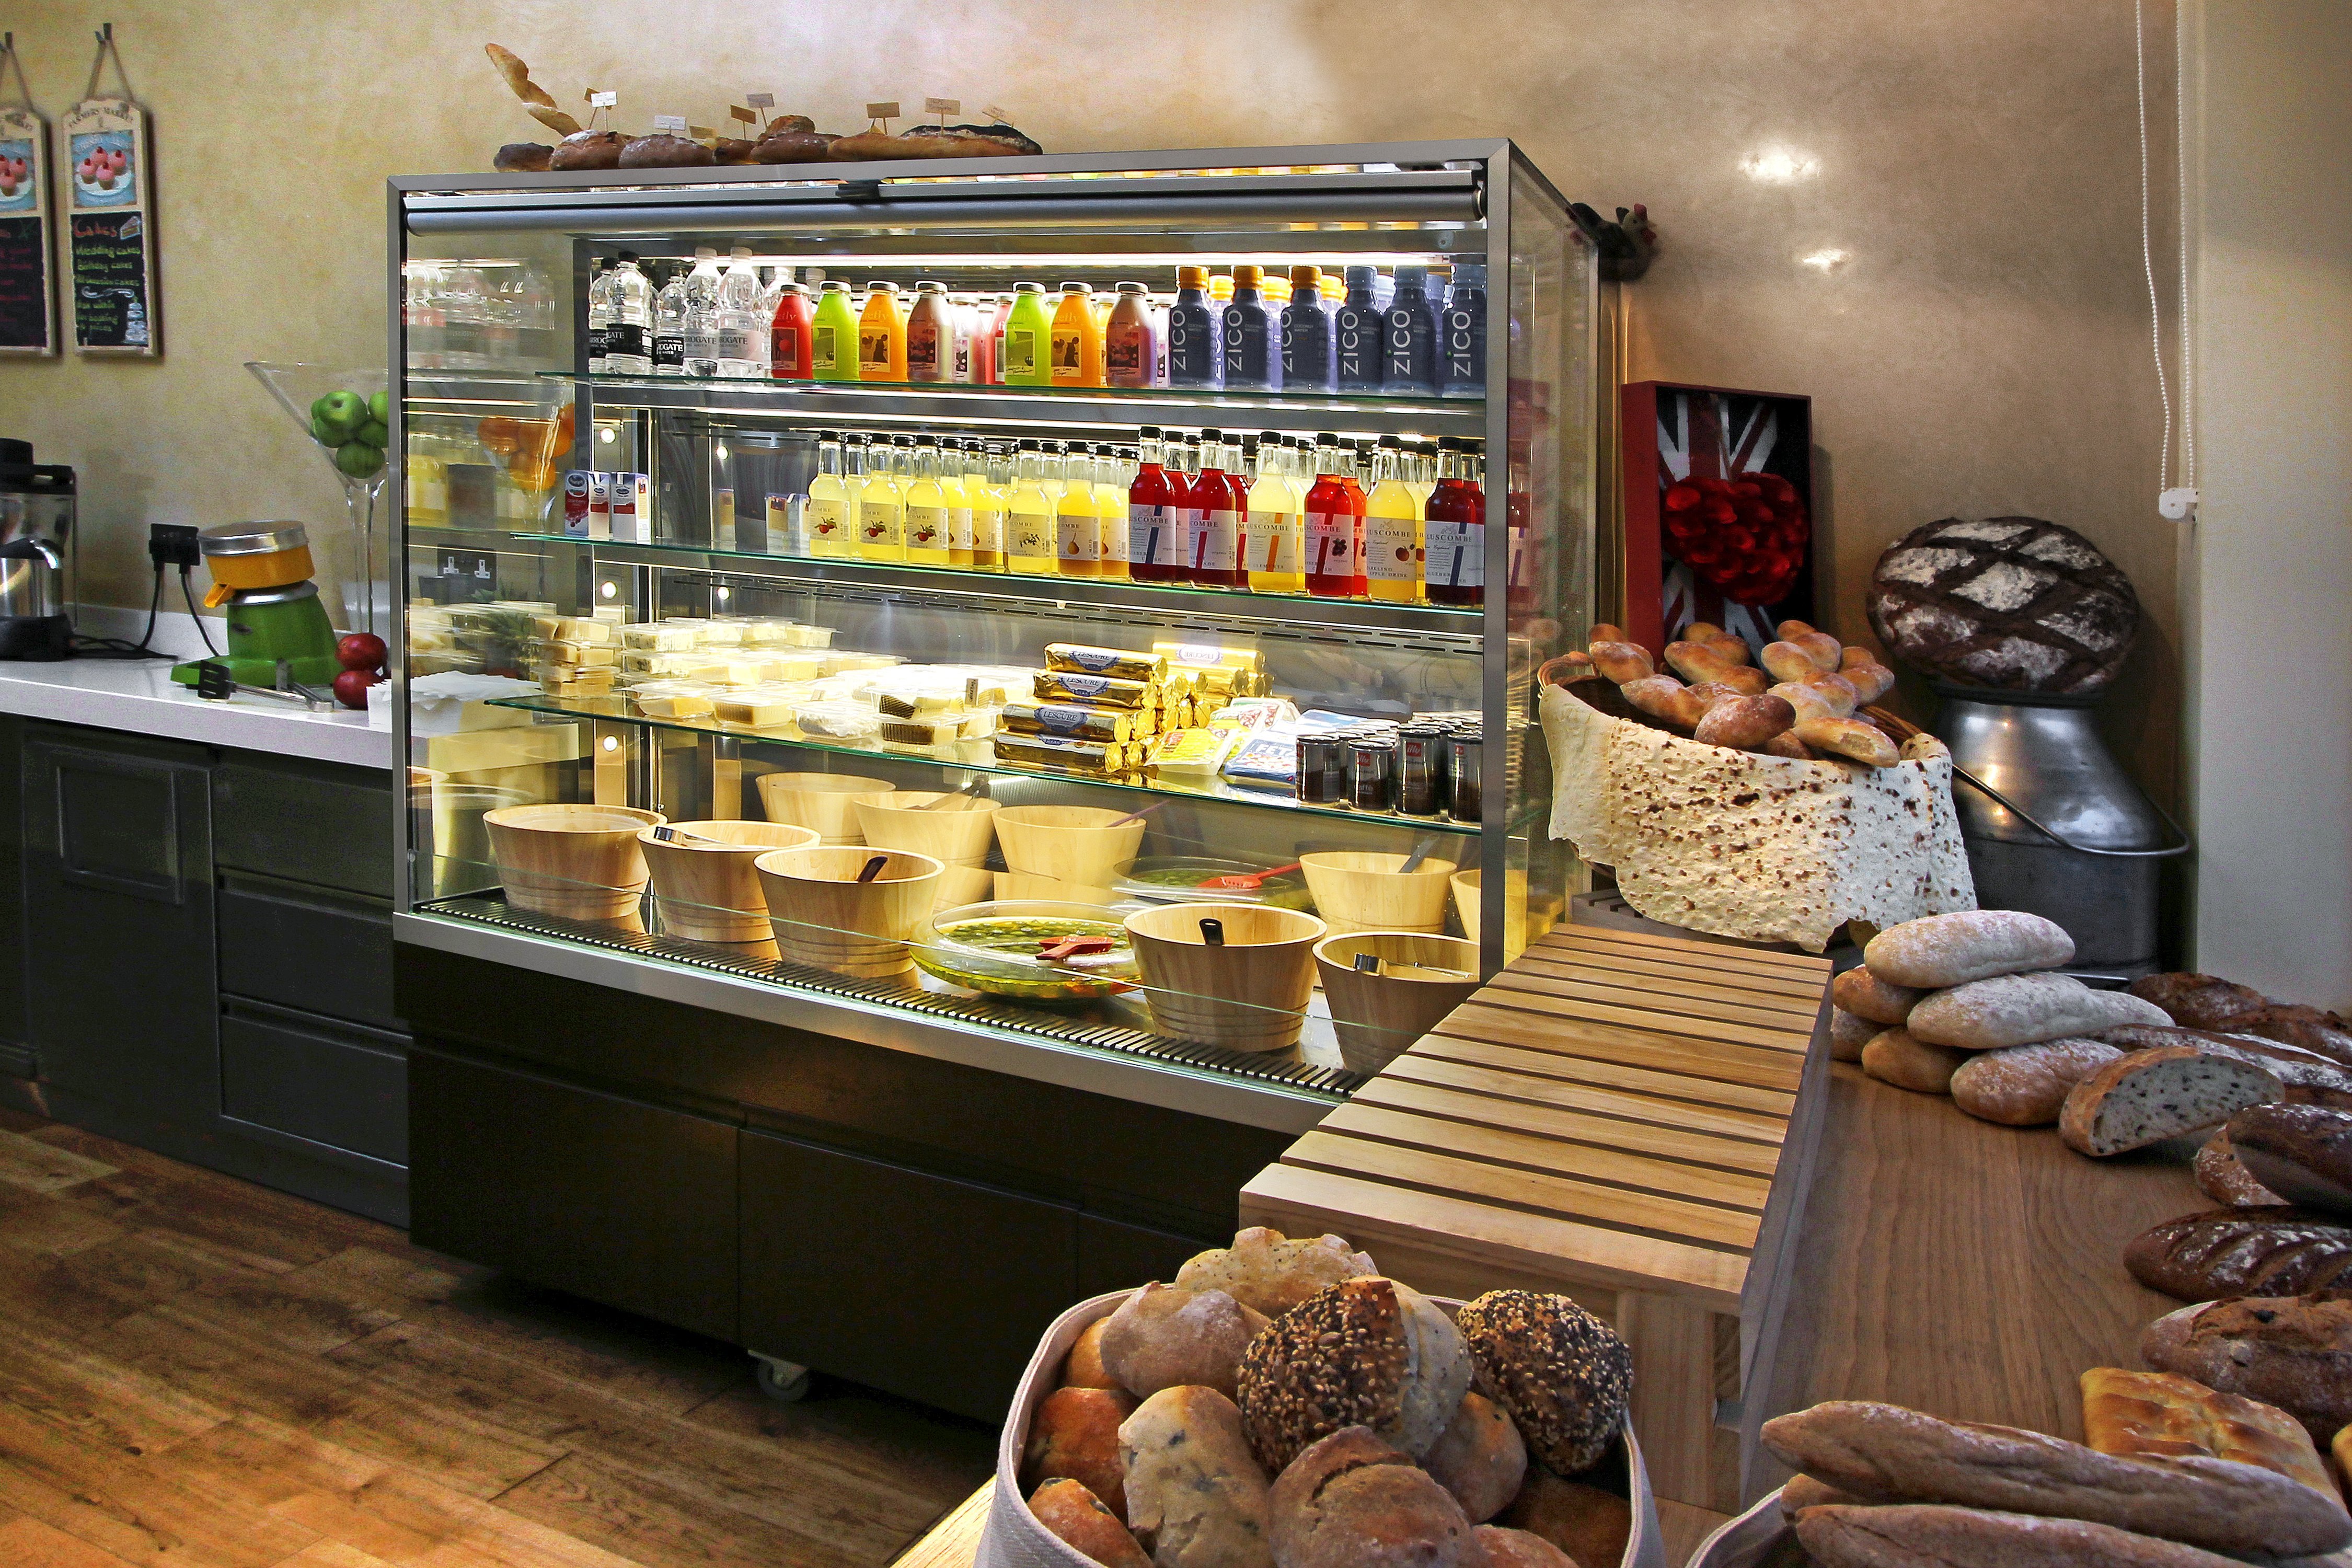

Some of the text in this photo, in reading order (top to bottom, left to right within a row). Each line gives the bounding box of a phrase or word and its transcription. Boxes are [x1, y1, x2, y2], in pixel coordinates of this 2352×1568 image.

[1172, 310, 1186, 371] ZICO
[1228, 310, 1243, 371] ZICO
[1282, 311, 1293, 373] ZICO
[1342, 312, 1359, 376] ZICO
[1392, 310, 1411, 375] ZICO
[1452, 312, 1471, 377] ZICO
[1067, 677, 1099, 686] LESCURE
[1043, 711, 1078, 721] LESCURE
